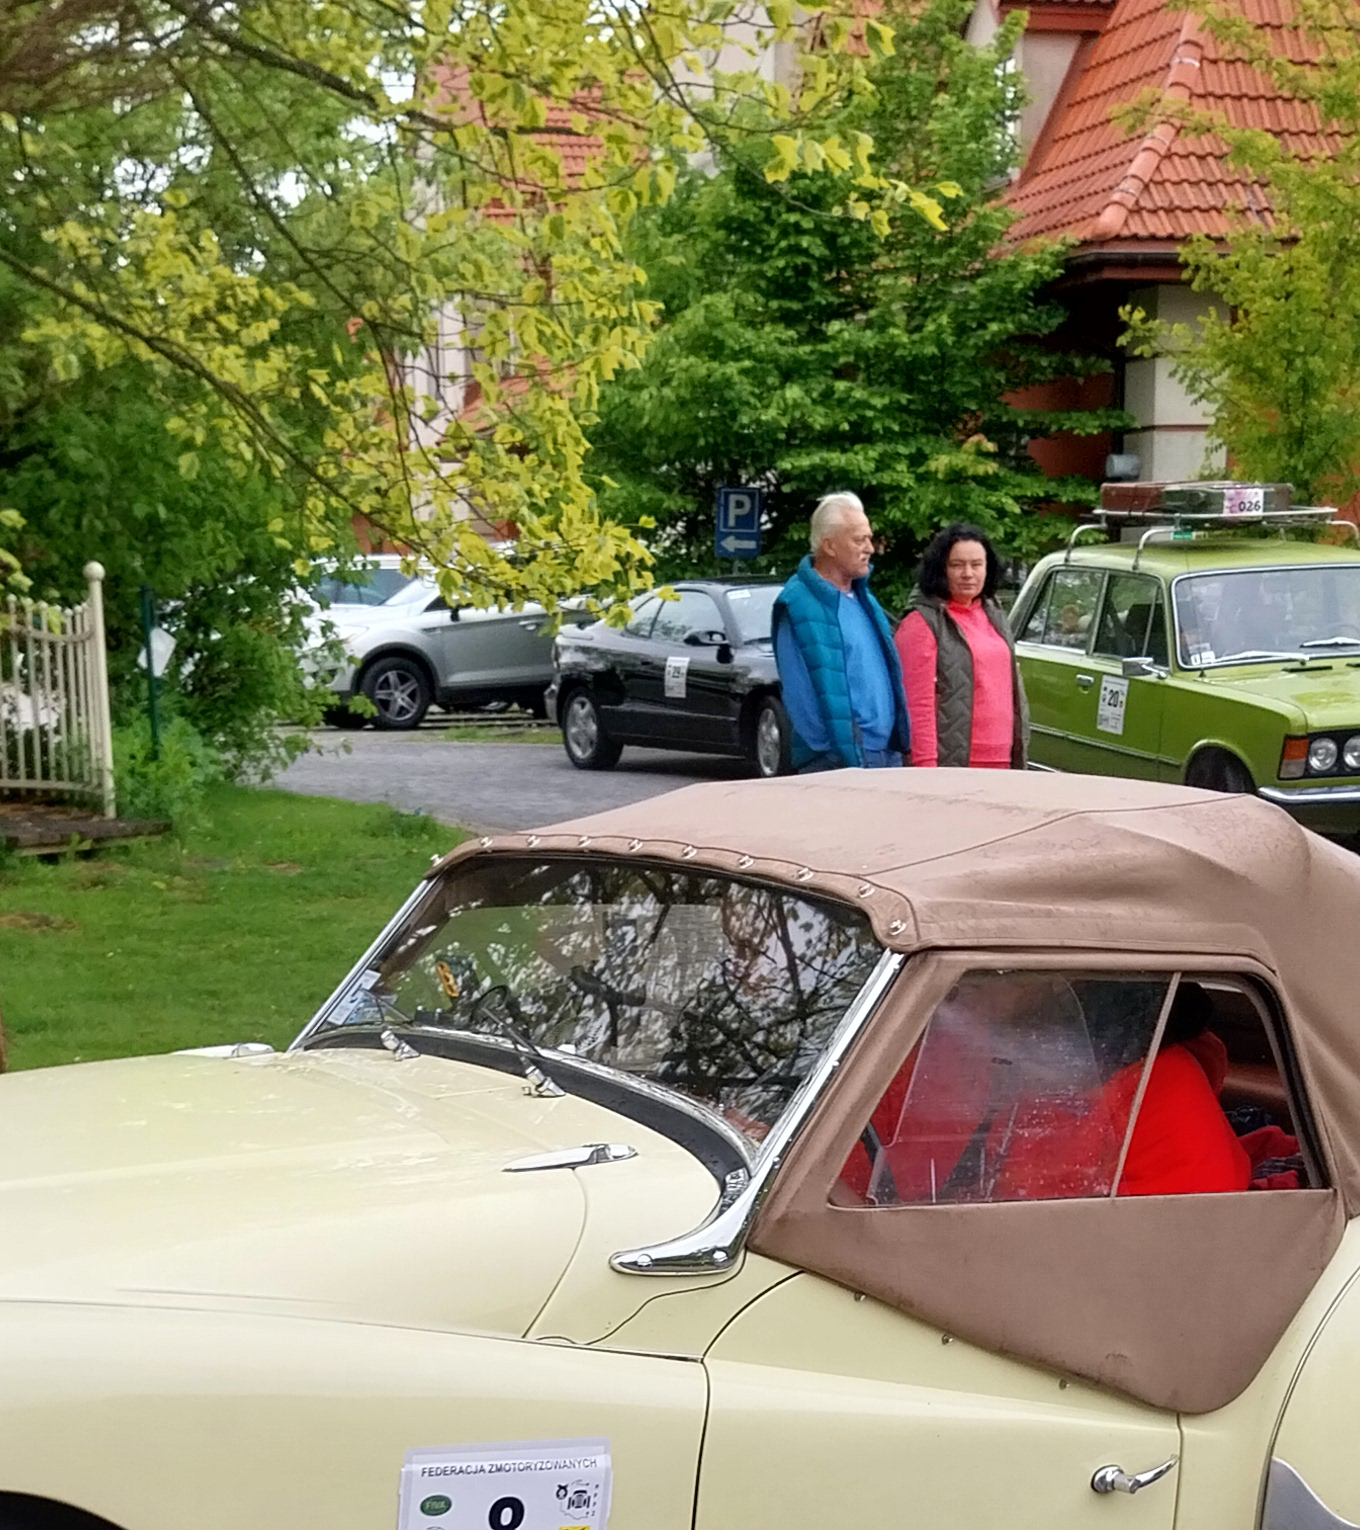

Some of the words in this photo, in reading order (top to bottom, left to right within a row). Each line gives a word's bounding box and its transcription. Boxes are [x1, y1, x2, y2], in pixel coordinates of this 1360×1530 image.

[727, 494, 752, 528] P
[1238, 500, 1261, 512] 026
[1107, 689, 1120, 708] 20
[421, 1463, 486, 1478] FEDERACJA
[488, 1457, 598, 1474] ZMOTORYZOWANYCH
